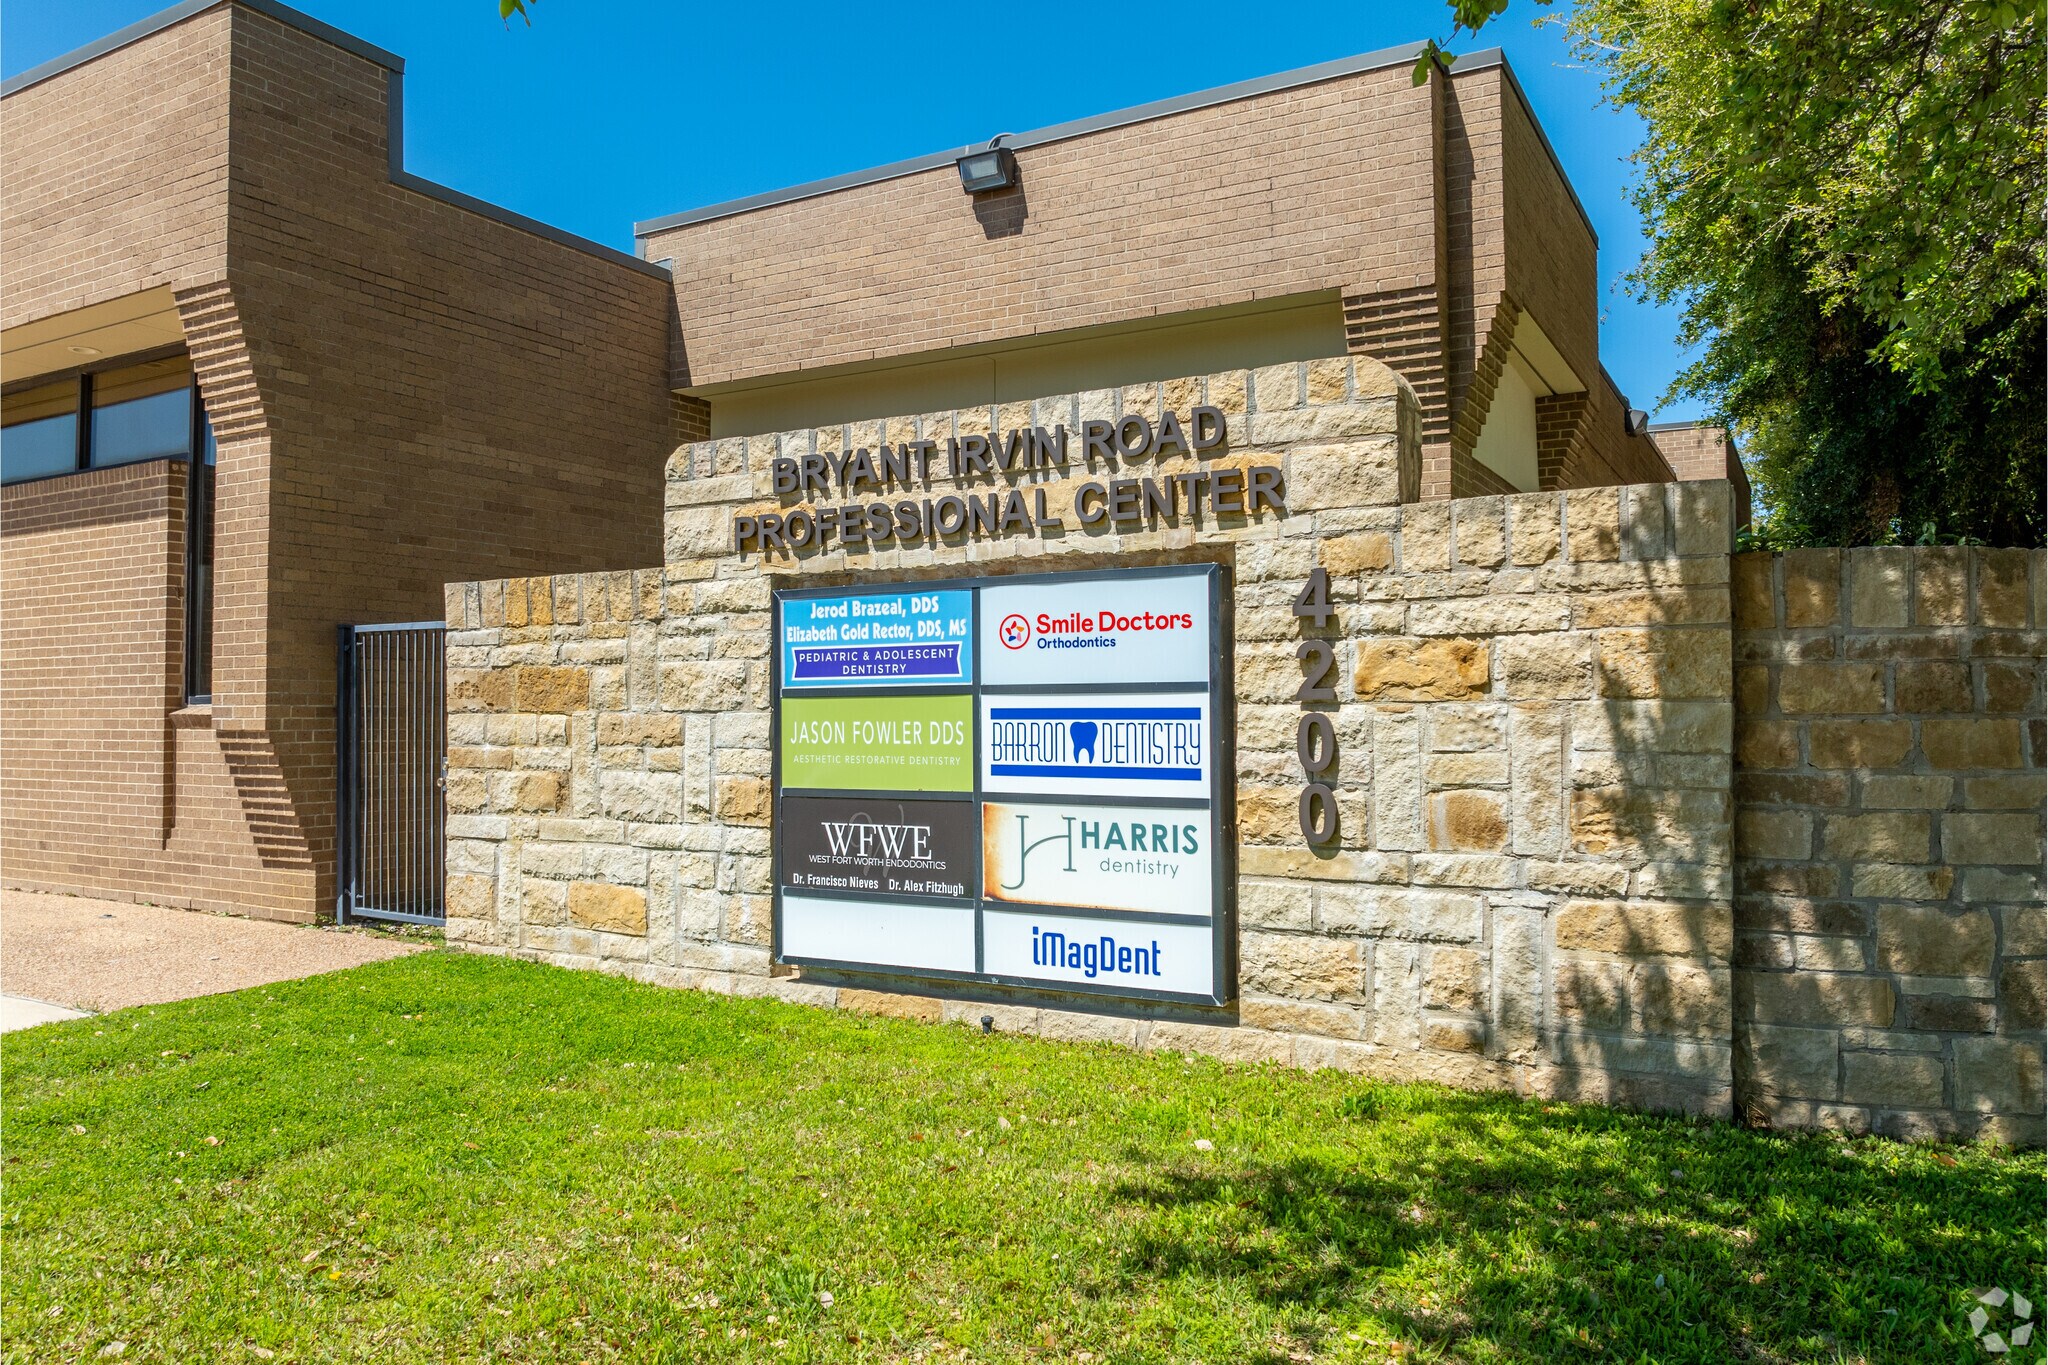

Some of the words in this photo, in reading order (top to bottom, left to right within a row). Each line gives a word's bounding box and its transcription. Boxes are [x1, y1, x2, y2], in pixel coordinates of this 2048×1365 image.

[772, 438, 935, 495] BRYANT
[947, 424, 1068, 476] IRVIN
[1082, 405, 1227, 460] ROAD
[735, 487, 1063, 552] PROFESSIONAL
[1076, 465, 1287, 524] CENTER
[810, 601, 848, 619] Jerod
[852, 598, 907, 618] Brazeal,
[911, 596, 939, 614] DDS
[786, 624, 838, 642] Elizabeth
[841, 622, 869, 641] Gold
[873, 621, 913, 641] Rector,
[917, 620, 945, 639] DDS,
[949, 618, 967, 636] MS
[1036, 612, 1094, 634] Smile
[1099, 611, 1193, 632] Doctors
[1037, 636, 1116, 649] Orthodontics
[799, 651, 858, 662] PEDIATRIC
[863, 651, 870, 661] &
[875, 648, 954, 660] ADOLESCENT
[842, 664, 907, 675] DENTISTRY
[1292, 567, 1337, 844] 4200
[790, 721, 845, 744] JASON
[853, 721, 922, 745] FOWLER
[930, 721, 964, 745] DDS
[991, 722, 1066, 762] BARRON
[1102, 722, 1201, 765] DENTISTRY
[793, 754, 841, 764] AESTHETIC
[845, 755, 905, 765] RESTORATIVE
[909, 756, 961, 766] DENTISTRY
[821, 822, 932, 860] WFWE
[1081, 821, 1199, 855] HARRIS
[809, 854, 831, 864] WEST
[832, 855, 852, 865] FORT
[854, 857, 884, 866] WORTH
[886, 859, 946, 870] ENDODONTICS
[1100, 858, 1179, 879] dentistry
[793, 873, 805, 885] Dr.
[807, 874, 847, 887] Francisco
[850, 877, 879, 889] Nieves
[889, 879, 901, 891] Dr.
[904, 880, 924, 892] Alex
[926, 881, 964, 897] Fitzhugh
[1032, 926, 1161, 978] iMagDent
